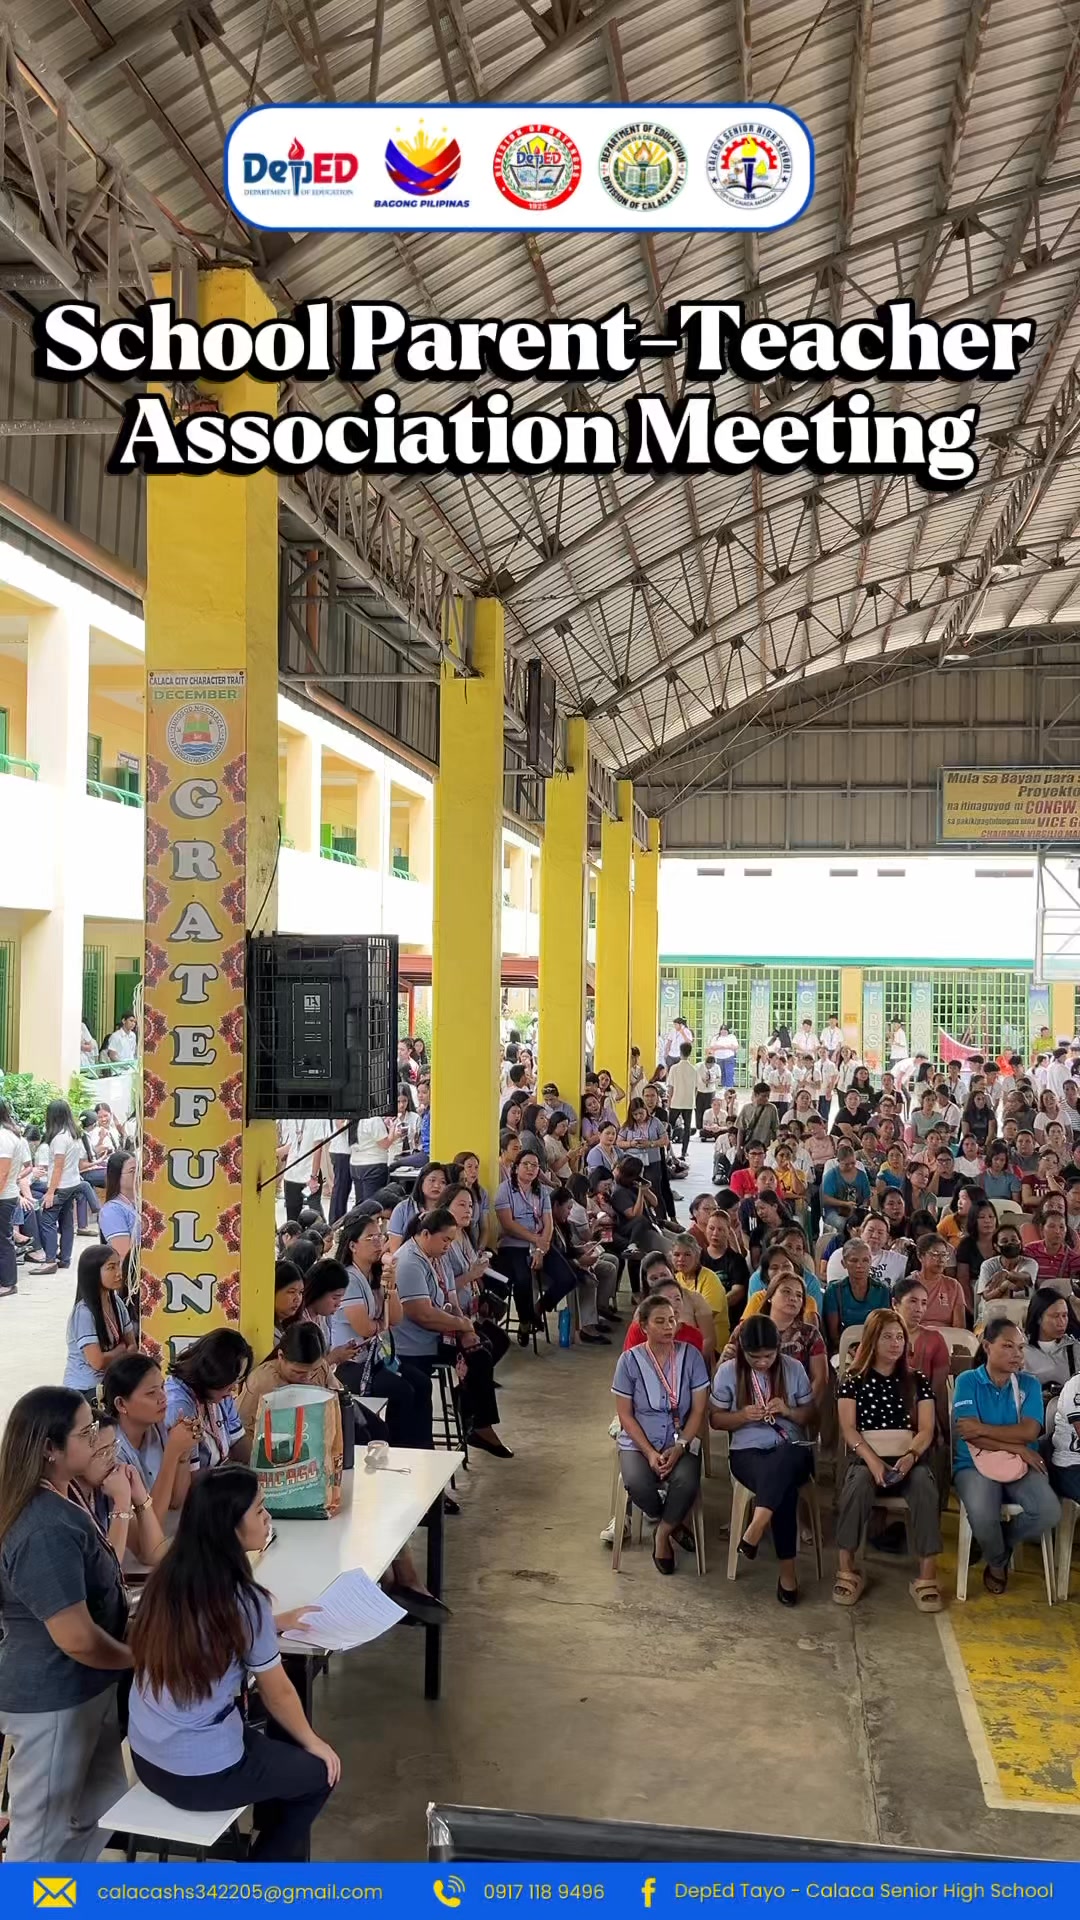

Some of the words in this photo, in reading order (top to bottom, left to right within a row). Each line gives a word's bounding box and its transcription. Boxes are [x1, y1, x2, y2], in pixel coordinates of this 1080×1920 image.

[149, 677, 174, 686] CALACA
[175, 677, 189, 685] CITY
[189, 676, 226, 685] CHARACTER
[227, 675, 245, 685] TRAIT
[154, 689, 237, 700] DECEMBER
[947, 773, 979, 784] Mula
[982, 775, 998, 784] sa
[1000, 773, 1042, 785] Bayan
[1043, 774, 1073, 785] para
[947, 802, 959, 811] na
[1025, 800, 1078, 815] CONGW.
[1037, 816, 1067, 827] VICE
